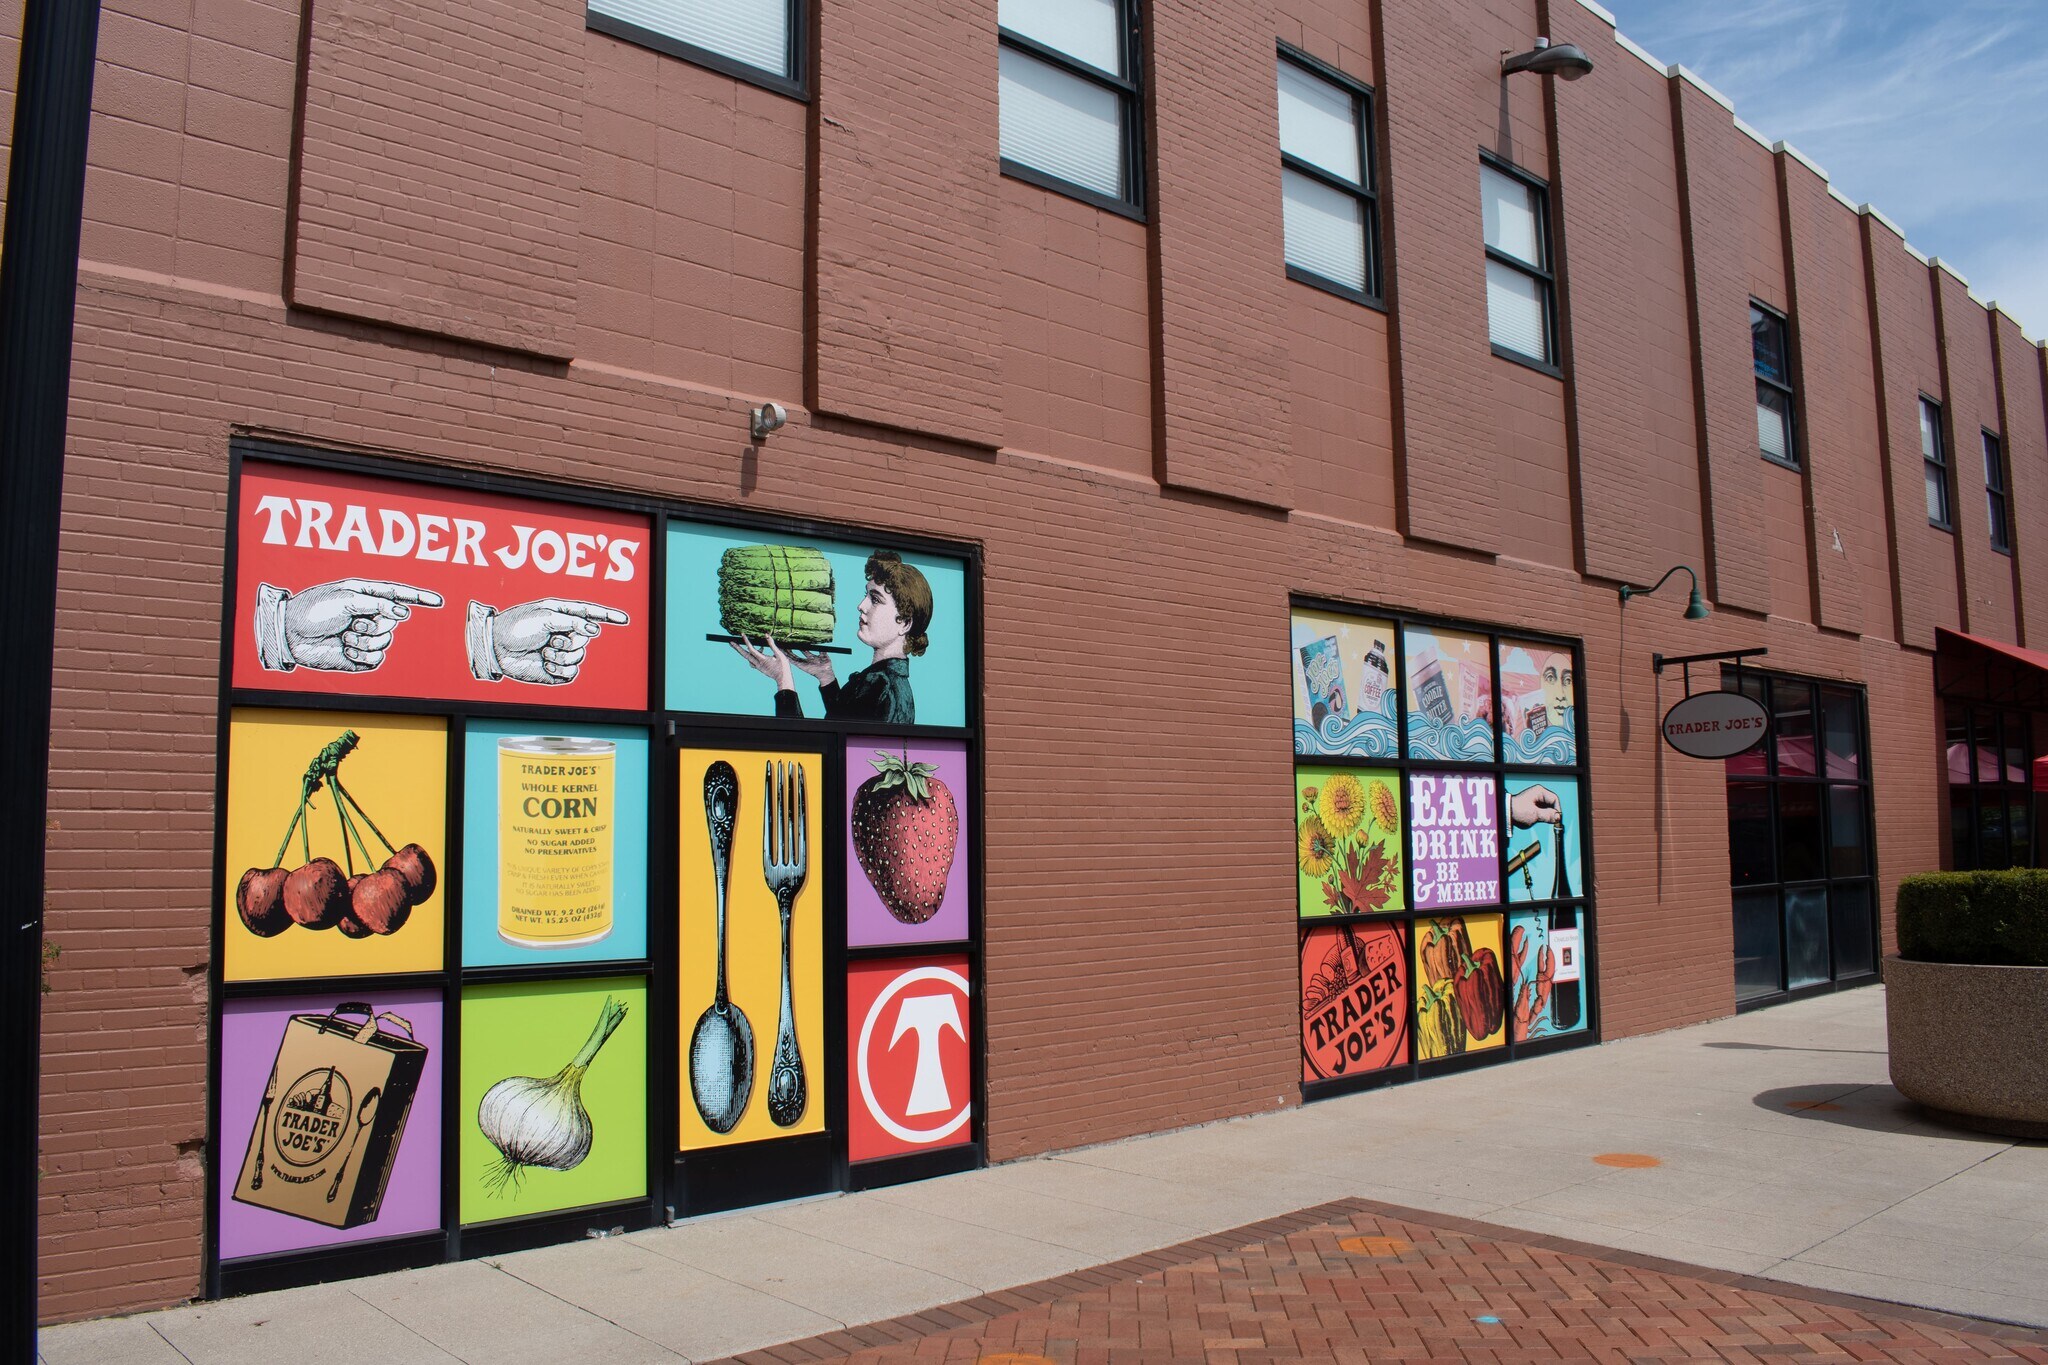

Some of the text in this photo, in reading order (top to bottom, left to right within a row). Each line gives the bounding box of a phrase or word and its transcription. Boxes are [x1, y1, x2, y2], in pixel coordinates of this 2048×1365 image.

[254, 495, 641, 582] TRADER JOE'S
[1364, 684, 1381, 698] COFFEE
[1422, 685, 1443, 708] COOKIE
[1668, 717, 1763, 735] TRADER JOE'S
[522, 764, 597, 776] TRADER JOE'S
[522, 782, 599, 793] WHOLE KERNEL
[523, 796, 598, 818] CORN
[1409, 774, 1495, 827] EAT
[512, 825, 552, 835] NATURALLY
[555, 828, 581, 836] SWEET
[527, 838, 596, 847] NO SUGAR ADDED
[537, 847, 597, 855] PRESERVATIVES
[1411, 829, 1497, 860] DRINK
[1413, 861, 1459, 902] & BE
[1437, 880, 1498, 903] MERRY
[511, 906, 542, 916] DRAINED
[576, 906, 587, 914] OZ
[515, 914, 528, 922] NET
[571, 914, 582, 922] OZ
[1310, 961, 1403, 1051] TRADER
[1332, 1002, 1396, 1074] JOE'S
[281, 1112, 340, 1138] TRADER
[282, 1131, 326, 1153] JOE'S
